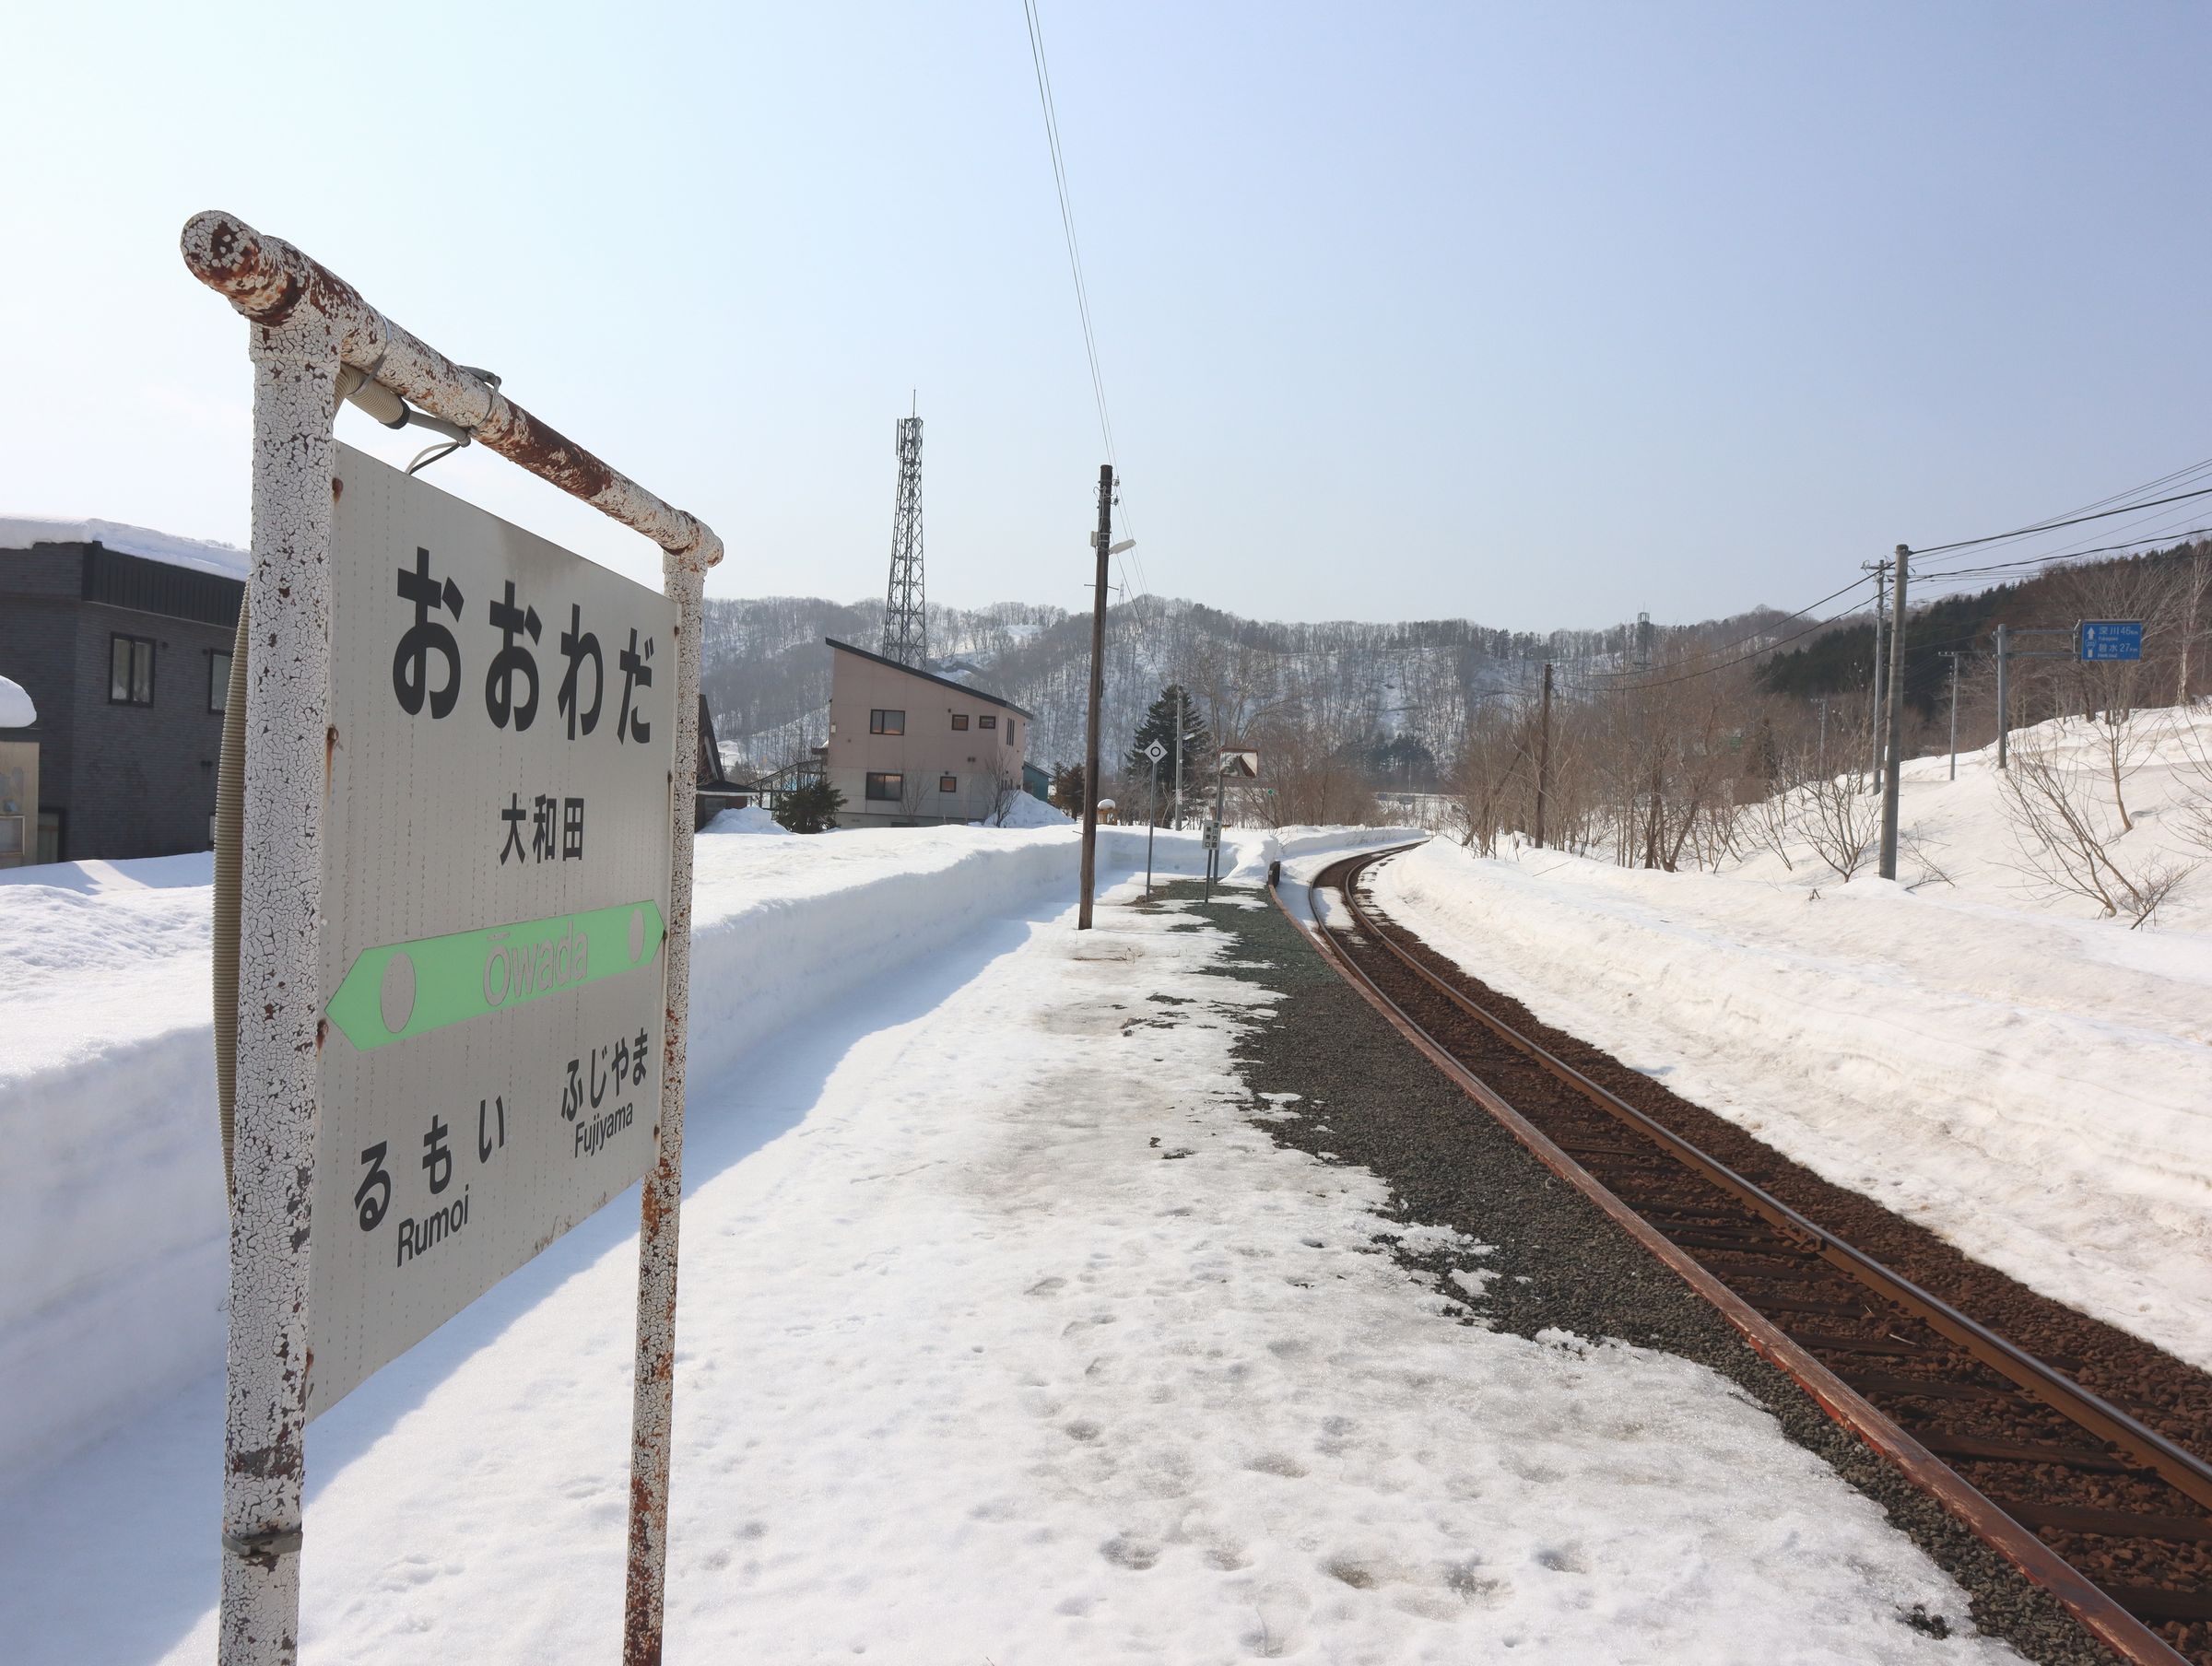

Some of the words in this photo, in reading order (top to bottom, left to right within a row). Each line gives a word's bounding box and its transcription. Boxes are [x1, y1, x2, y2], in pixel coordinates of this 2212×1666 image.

[392, 546, 654, 745] おおわだ
[500, 792, 584, 865] 大和田
[483, 921, 589, 1007] Ōwada
[560, 1027, 650, 1122] ふじやま
[354, 1095, 505, 1233] るもい
[574, 1101, 634, 1158] Fujiyama
[396, 1186, 470, 1267] Rumoi
